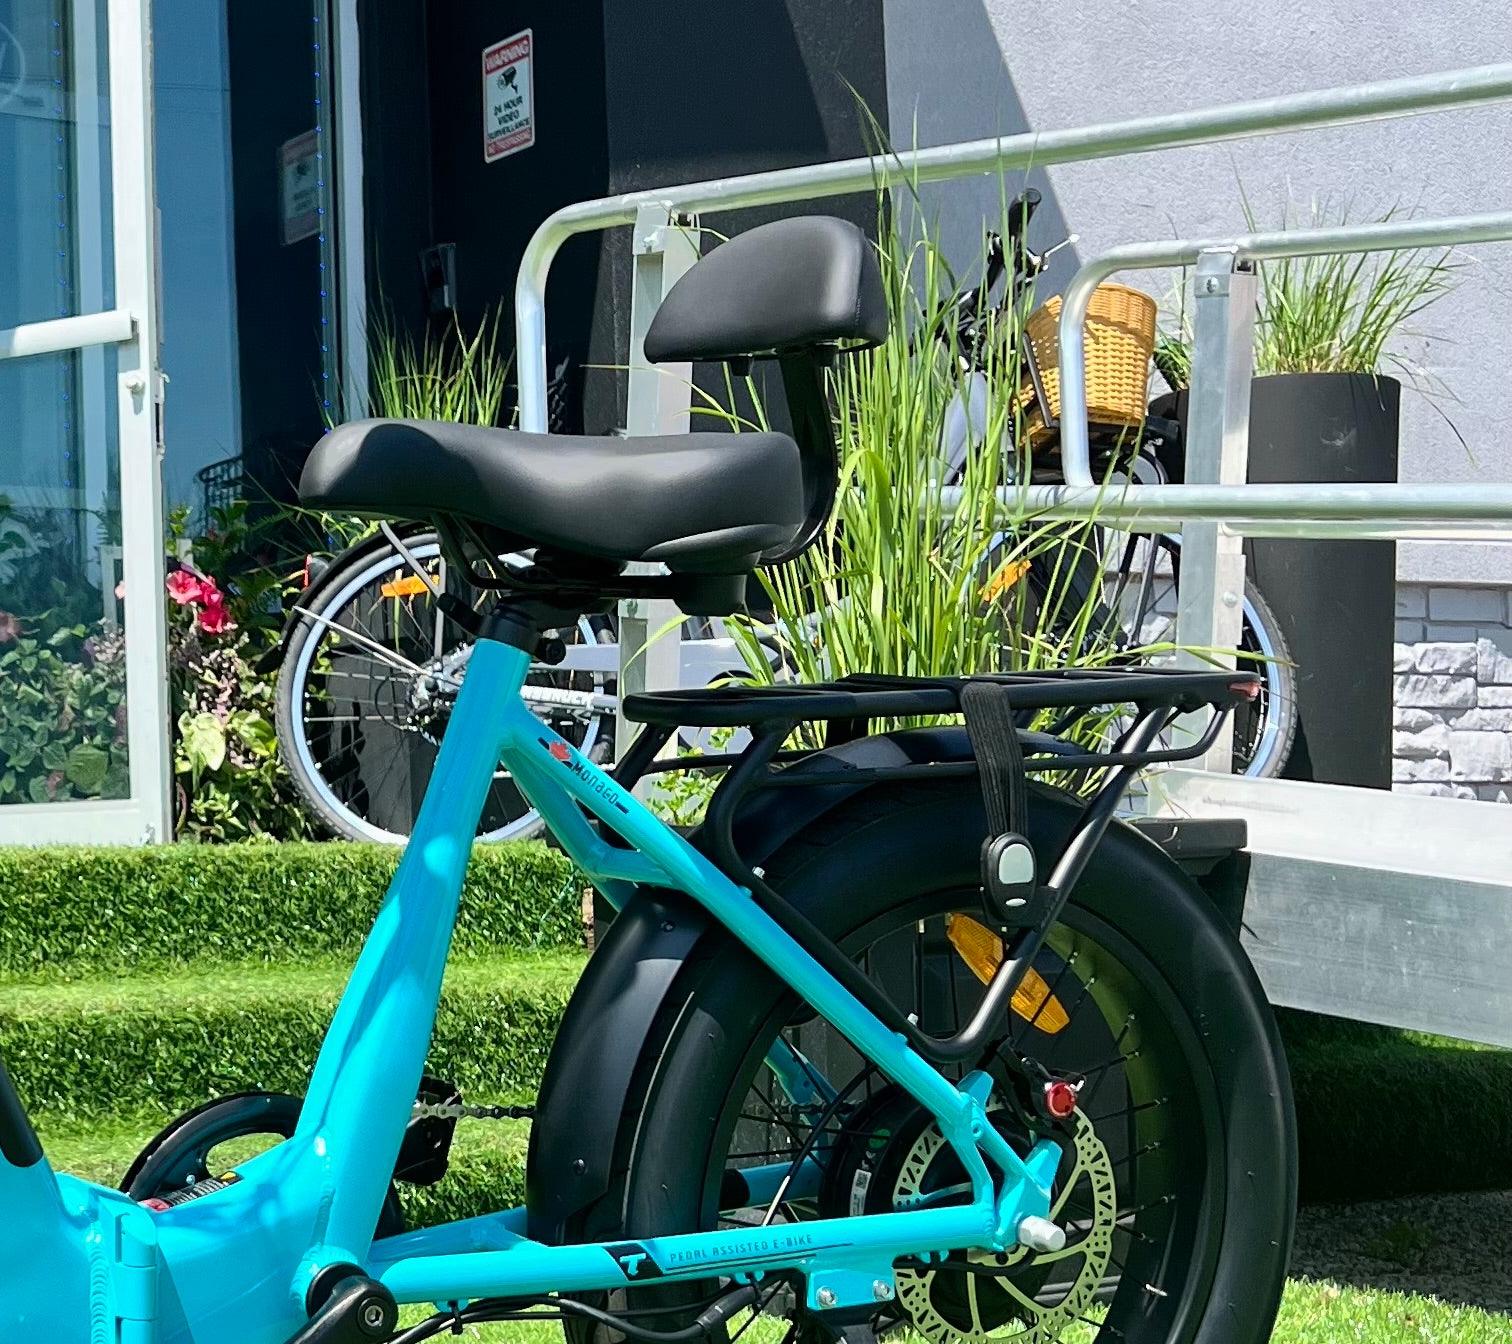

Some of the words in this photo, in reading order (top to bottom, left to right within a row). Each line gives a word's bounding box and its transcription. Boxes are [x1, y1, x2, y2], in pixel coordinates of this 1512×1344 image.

[670, 1249, 707, 1263] PEDAL
[712, 1240, 769, 1256] ASSISTED
[772, 1234, 813, 1249] E-BIKE
